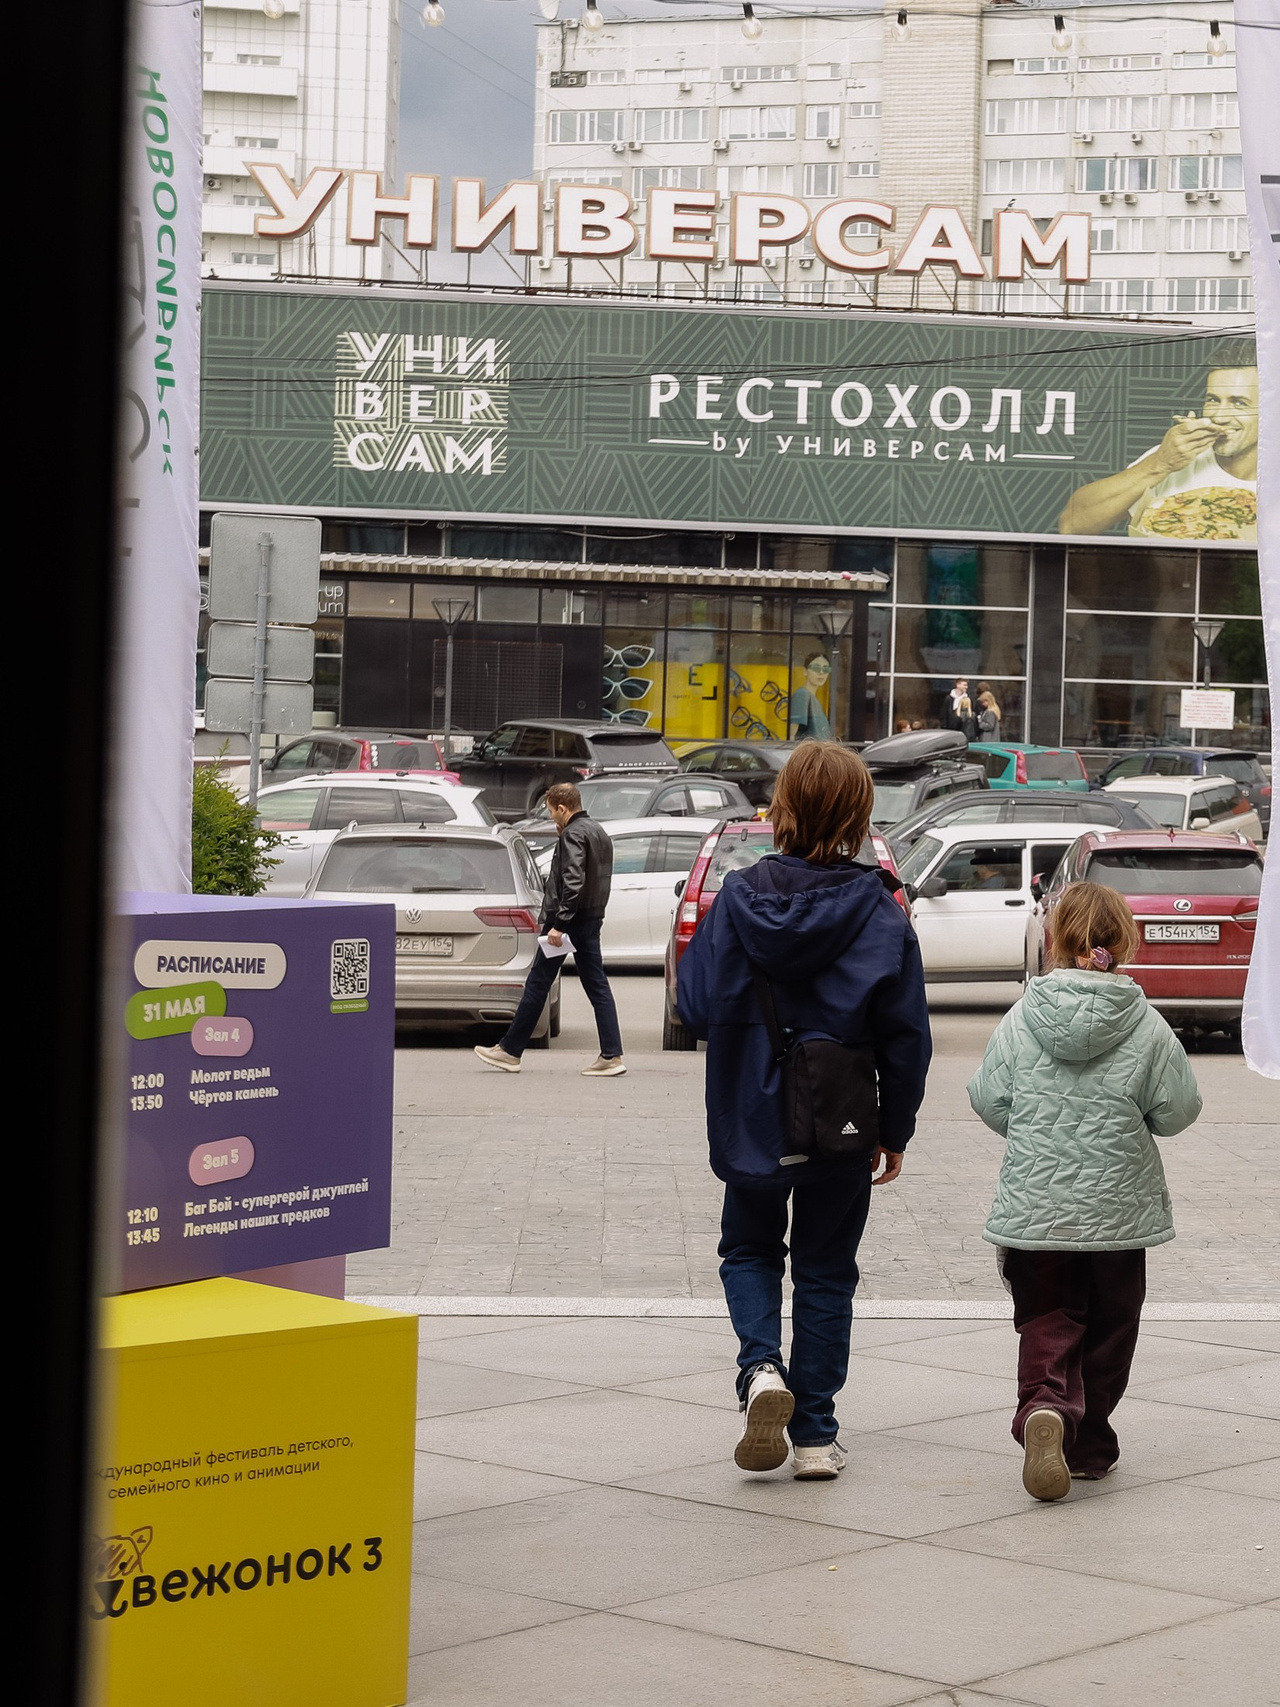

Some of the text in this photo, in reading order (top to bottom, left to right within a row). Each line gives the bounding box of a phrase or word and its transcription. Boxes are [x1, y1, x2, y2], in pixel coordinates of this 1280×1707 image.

[245, 161, 1092, 286] УНИВЕРСАМ
[349, 332, 497, 377] УНИ
[354, 379, 491, 426] ВЕР
[648, 373, 1076, 436] РЕСТОХОЛЛ
[347, 432, 493, 476] САМ
[712, 431, 1006, 462] by УНИВЕРСАМ
[430, 936, 452, 948] 154
[1198, 926, 1218, 935] 154
[157, 956, 266, 974] РАСПИСАНИЕ
[144, 996, 206, 1022] 31 МАЯ
[205, 1027, 240, 1042] Зал 4
[131, 1072, 164, 1090] 12:00
[191, 1067, 271, 1084] Молот ведьм
[131, 1094, 164, 1112] 13:50
[190, 1086, 280, 1108] Чёртов камень
[203, 1148, 240, 1170] Зал 5
[185, 1202, 207, 1217] Баг
[209, 1196, 232, 1214] Бой
[241, 1186, 310, 1211] супергерой
[311, 1178, 369, 1201] джунглей
[127, 1207, 159, 1225] 12:10
[184, 1206, 330, 1238] Легенды наших предков
[127, 1227, 160, 1246] 13:45
[206, 1446, 284, 1468] фестиваль
[288, 1436, 354, 1456] детского,
[108, 1460, 320, 1499] семейного кино и анимации
[364, 1536, 383, 1572] 3
